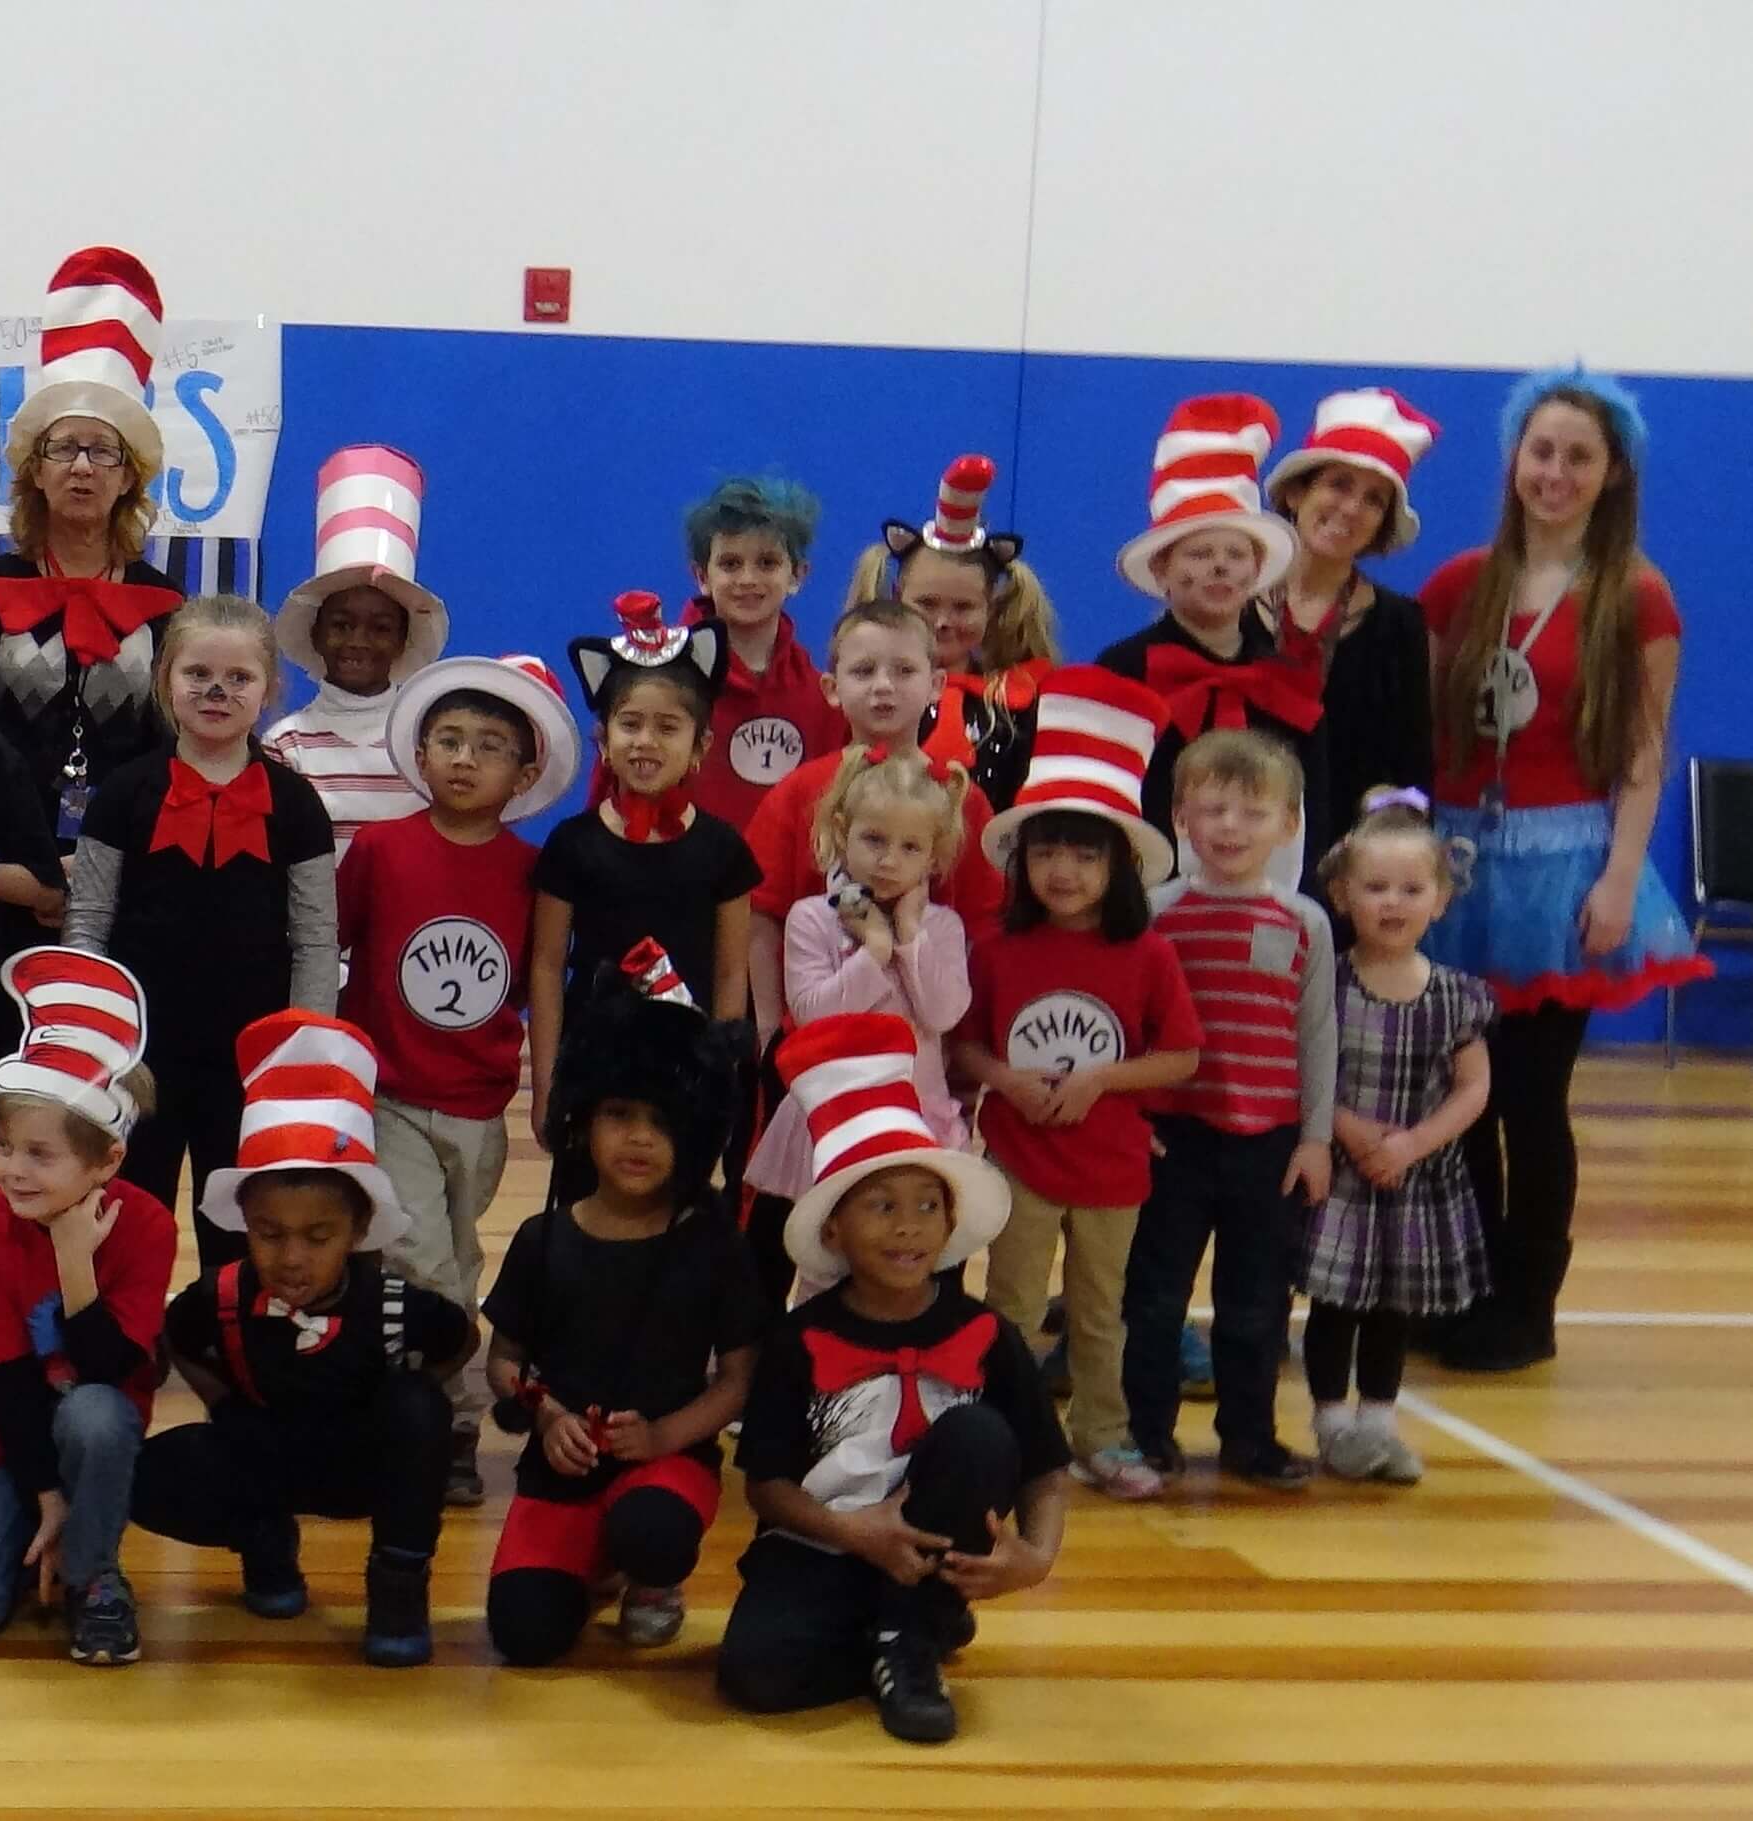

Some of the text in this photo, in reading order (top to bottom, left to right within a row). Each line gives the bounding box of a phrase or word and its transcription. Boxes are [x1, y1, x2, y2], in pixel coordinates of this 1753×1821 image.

[163, 340, 200, 369] #5
[760, 749, 773, 770] 1
[407, 934, 500, 983] THING
[434, 980, 467, 1017] 2
[1013, 1007, 1111, 1055] THING
